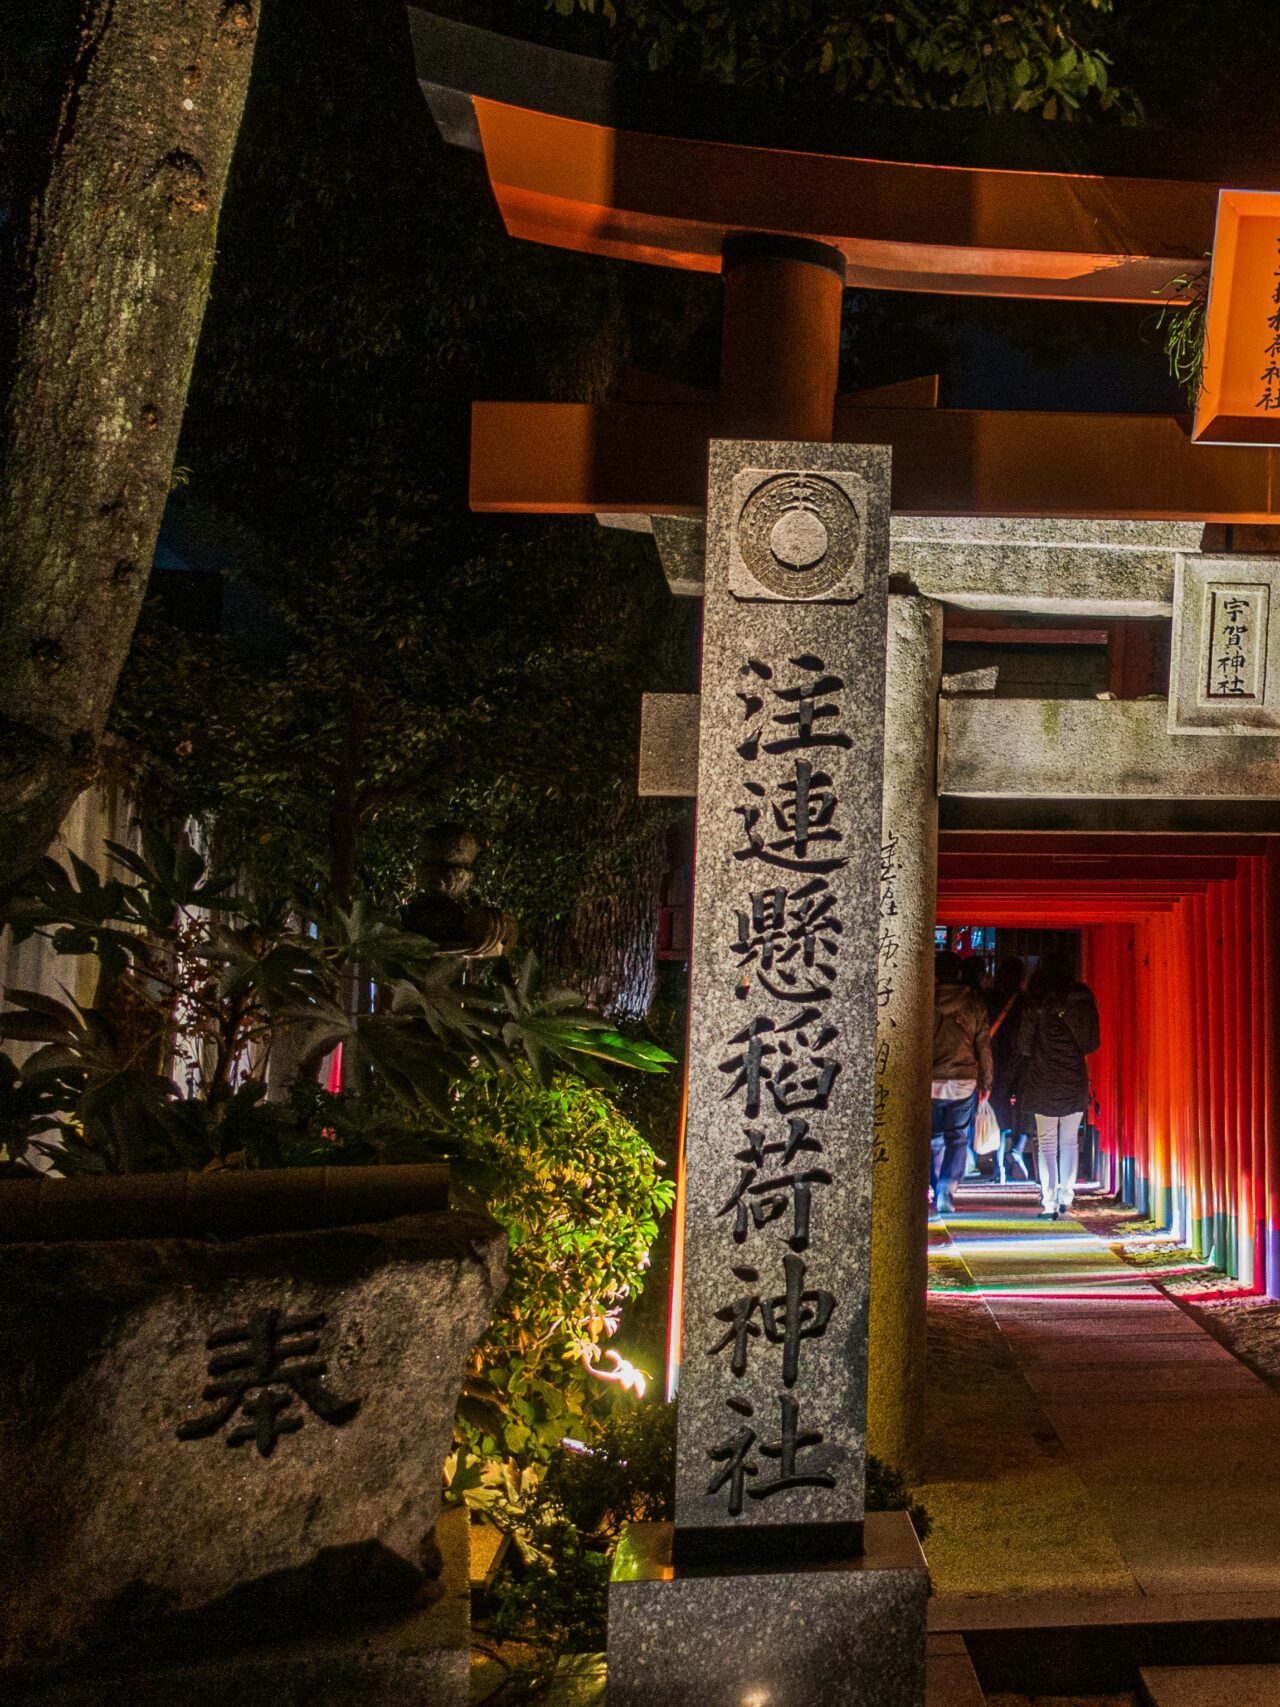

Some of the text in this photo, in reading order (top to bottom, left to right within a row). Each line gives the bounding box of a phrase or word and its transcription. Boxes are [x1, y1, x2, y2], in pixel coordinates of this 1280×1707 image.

[1217, 597, 1250, 694] 宇賀神社
[176, 1308, 362, 1459] 奉
